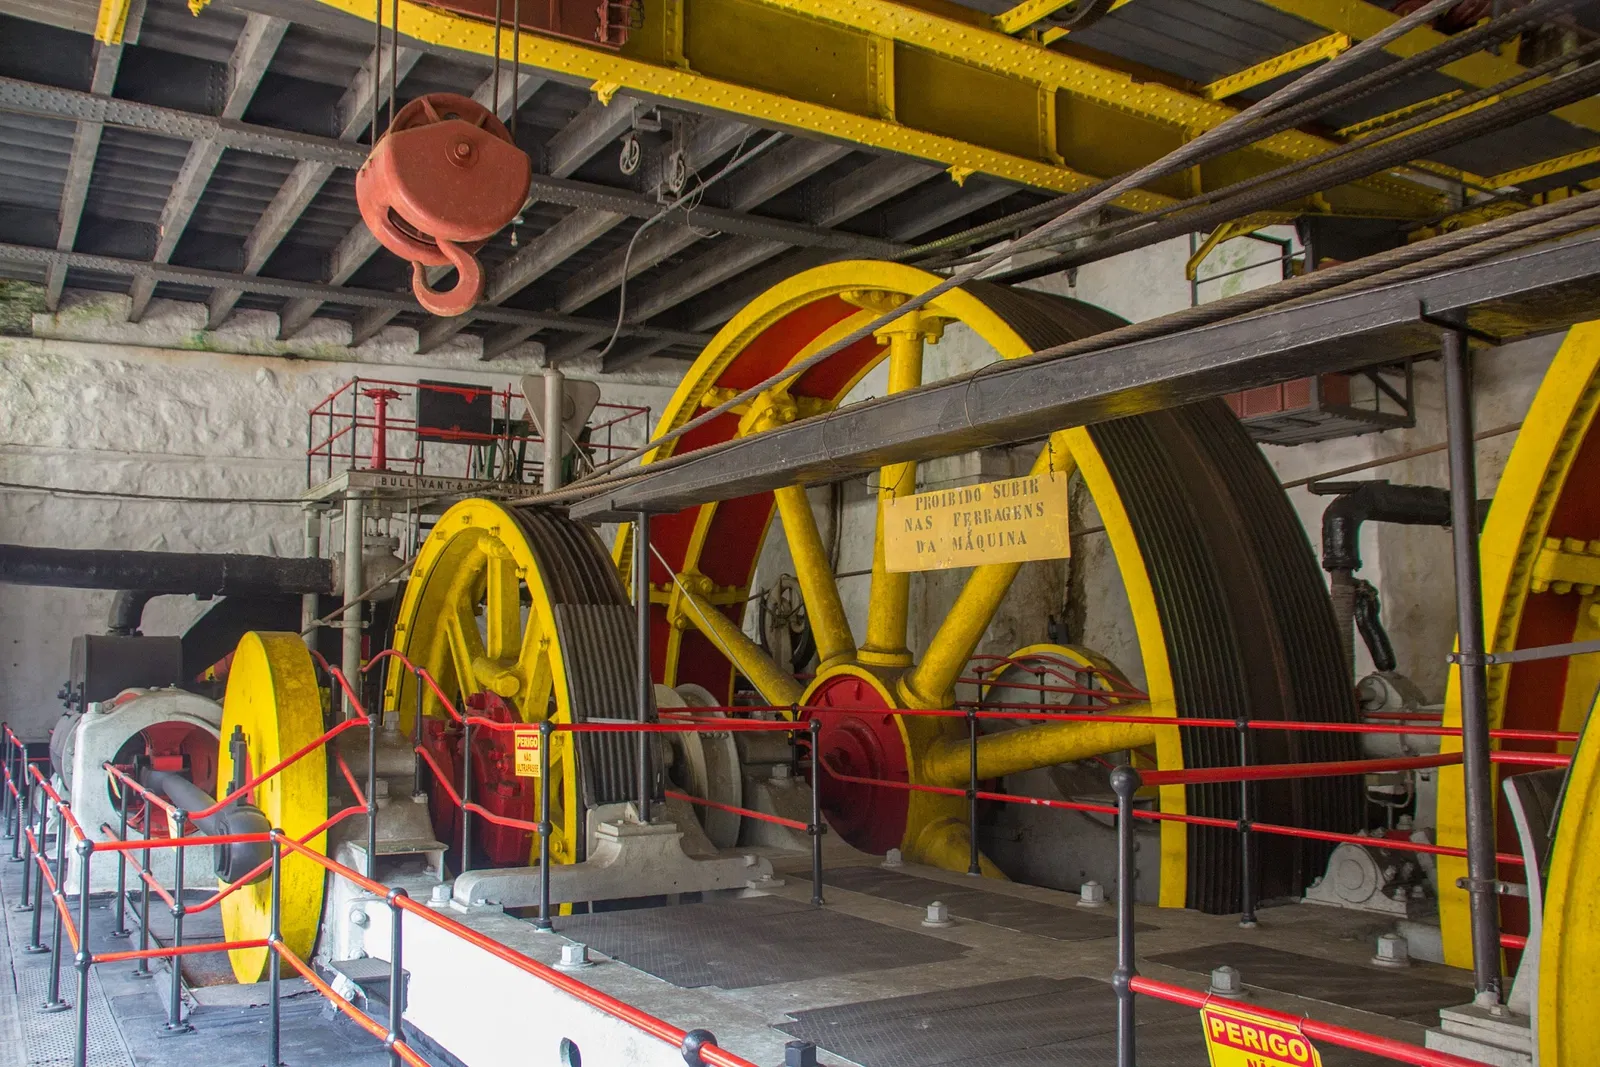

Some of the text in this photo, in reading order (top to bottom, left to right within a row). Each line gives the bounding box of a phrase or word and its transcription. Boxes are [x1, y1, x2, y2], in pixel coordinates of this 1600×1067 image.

[381, 476, 453, 490] BULLVANT
[915, 478, 1040, 512] PROIBIDO SUBIR
[904, 501, 1045, 533] NAS FERRAGENS
[916, 539, 937, 554] DA
[516, 736, 538, 748] PERIGO
[1209, 1016, 1309, 1063] PERIGO
